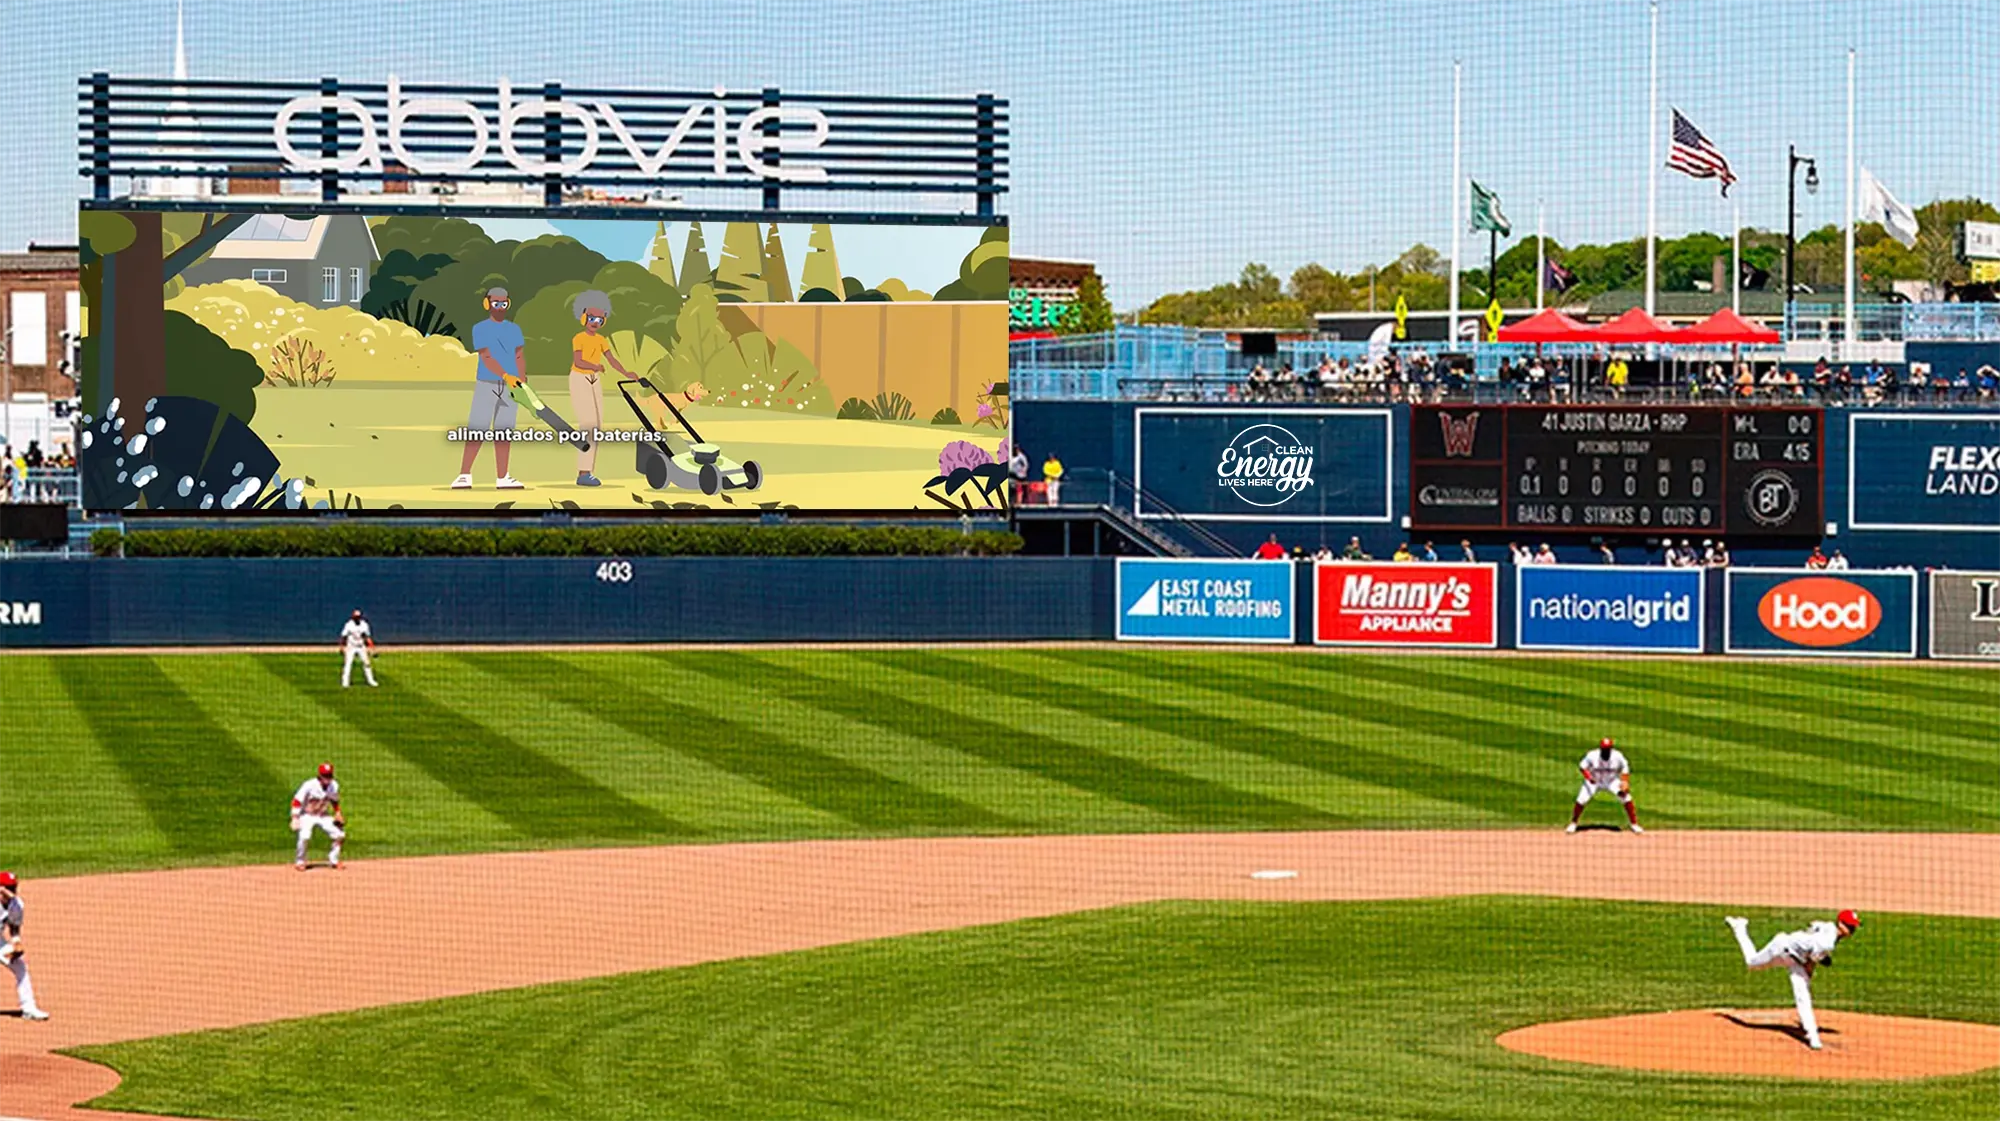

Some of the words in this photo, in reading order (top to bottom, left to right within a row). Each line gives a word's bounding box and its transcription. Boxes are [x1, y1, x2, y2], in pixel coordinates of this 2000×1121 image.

[272, 74, 830, 182] abbvie
[1542, 413, 1558, 431] 41
[1559, 413, 1606, 431] JUSTIN
[1607, 413, 1651, 432] GARZA
[1660, 413, 1688, 432] RHP
[447, 427, 554, 442] alimentados
[558, 429, 588, 443] por
[593, 427, 667, 442] baterías.
[1275, 446, 1314, 455] CLEAN
[1734, 441, 1760, 461] ERA
[1783, 442, 1811, 461] 4.15
[1928, 445, 2000, 471] FLEX
[1217, 447, 1315, 492] Energy
[1218, 478, 1246, 487] LIVES
[1520, 475, 1541, 495] 0.1
[1558, 475, 1569, 495] 0
[1591, 475, 1602, 496] 0
[1624, 475, 1636, 496] 0
[1658, 475, 1669, 496] 0
[1692, 476, 1703, 497] 0
[1925, 473, 2000, 495] LAND
[1517, 504, 1557, 523] BALLS
[1561, 505, 1573, 524] 0
[1583, 505, 1635, 525] STRIKES
[1639, 506, 1650, 525] 0
[1662, 507, 1696, 526] OUTS
[1700, 507, 1712, 526] 0
[595, 561, 633, 582] 403
[1161, 579, 1200, 598] EAST
[1204, 579, 1252, 598] COAST
[1340, 574, 1472, 615] Manny's
[1161, 598, 1210, 617] METAL
[1214, 599, 1282, 619] ROOFING
[1530, 591, 1690, 628] nationalgrid
[1772, 594, 1867, 629] Hood
[1359, 614, 1453, 633] APPLIANCE
